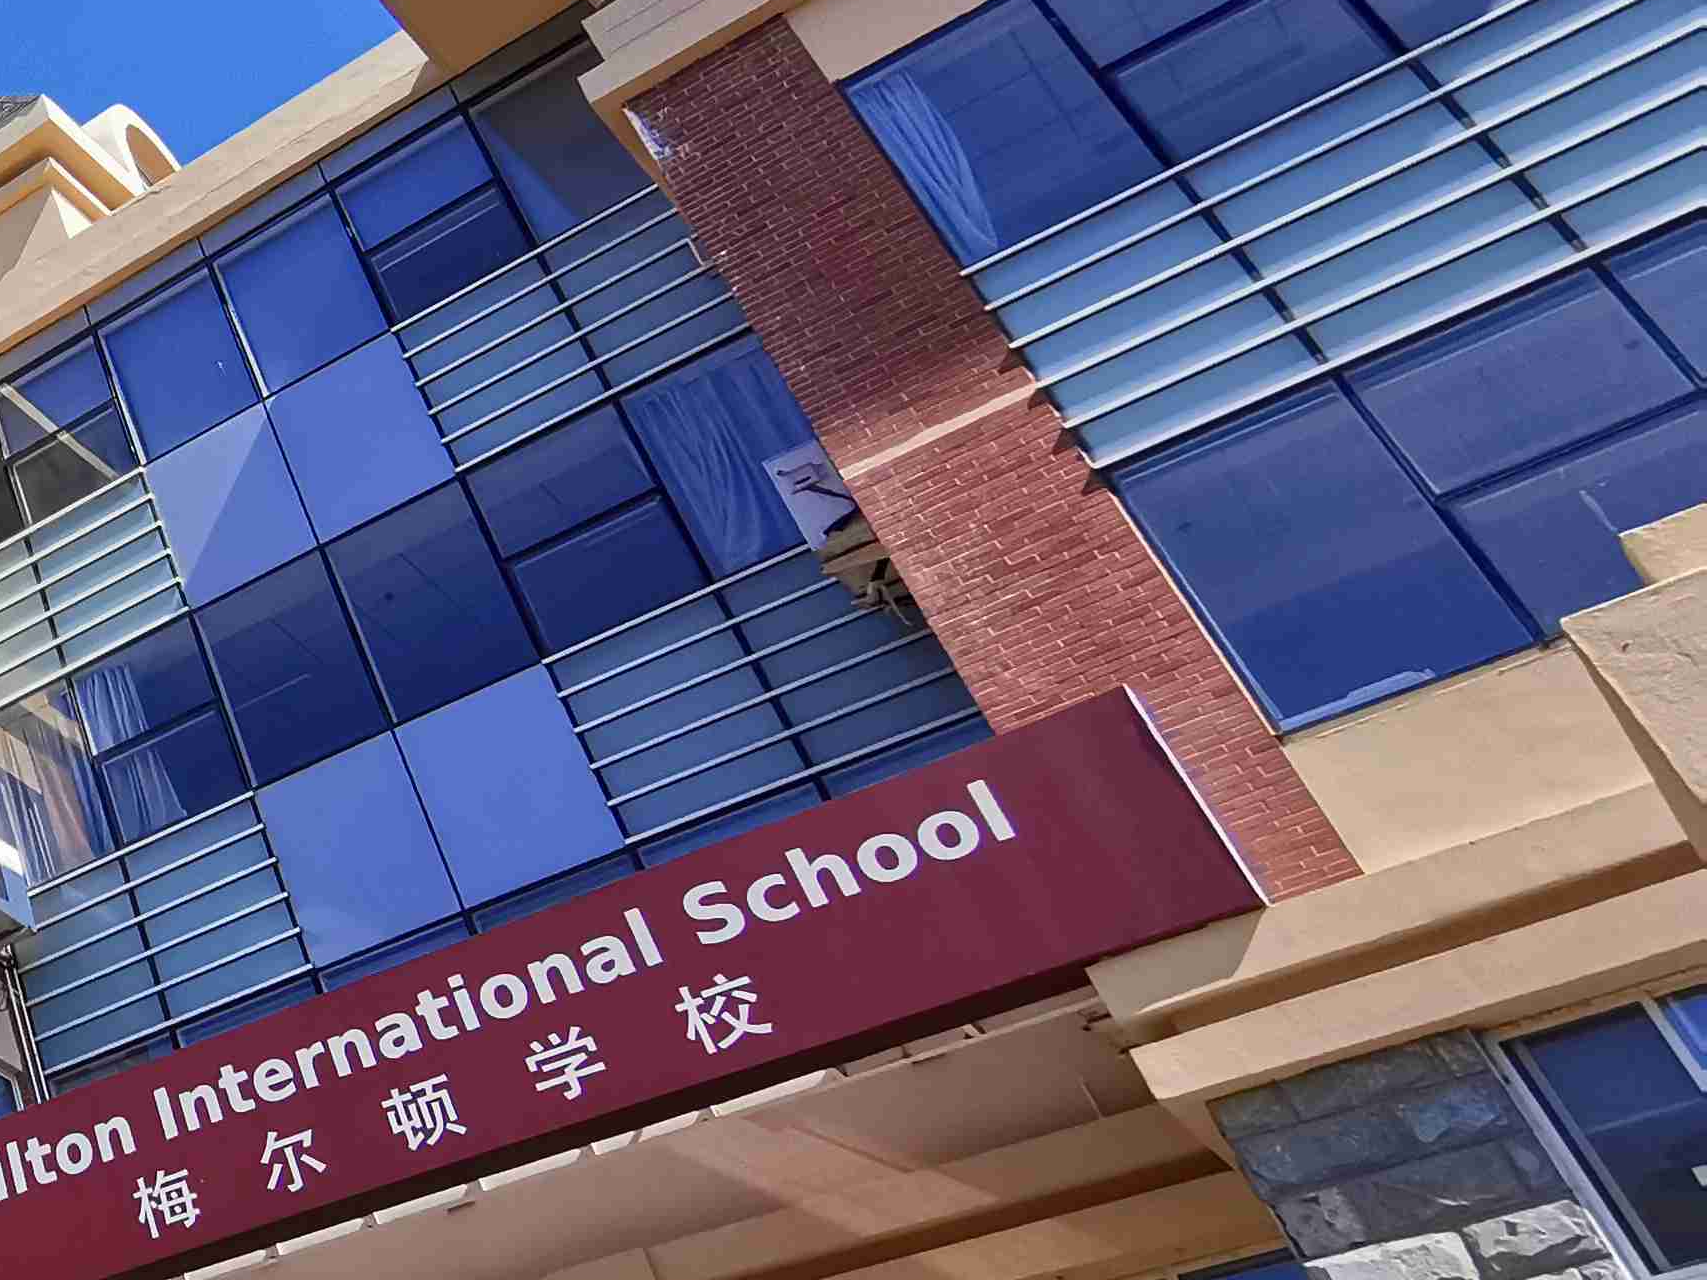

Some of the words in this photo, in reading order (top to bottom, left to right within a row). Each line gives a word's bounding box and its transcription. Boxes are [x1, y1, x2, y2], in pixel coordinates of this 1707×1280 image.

[132, 973, 774, 1239] 梅尔顿学校
[153, 907, 665, 1142] International
[682, 779, 1017, 946] School
